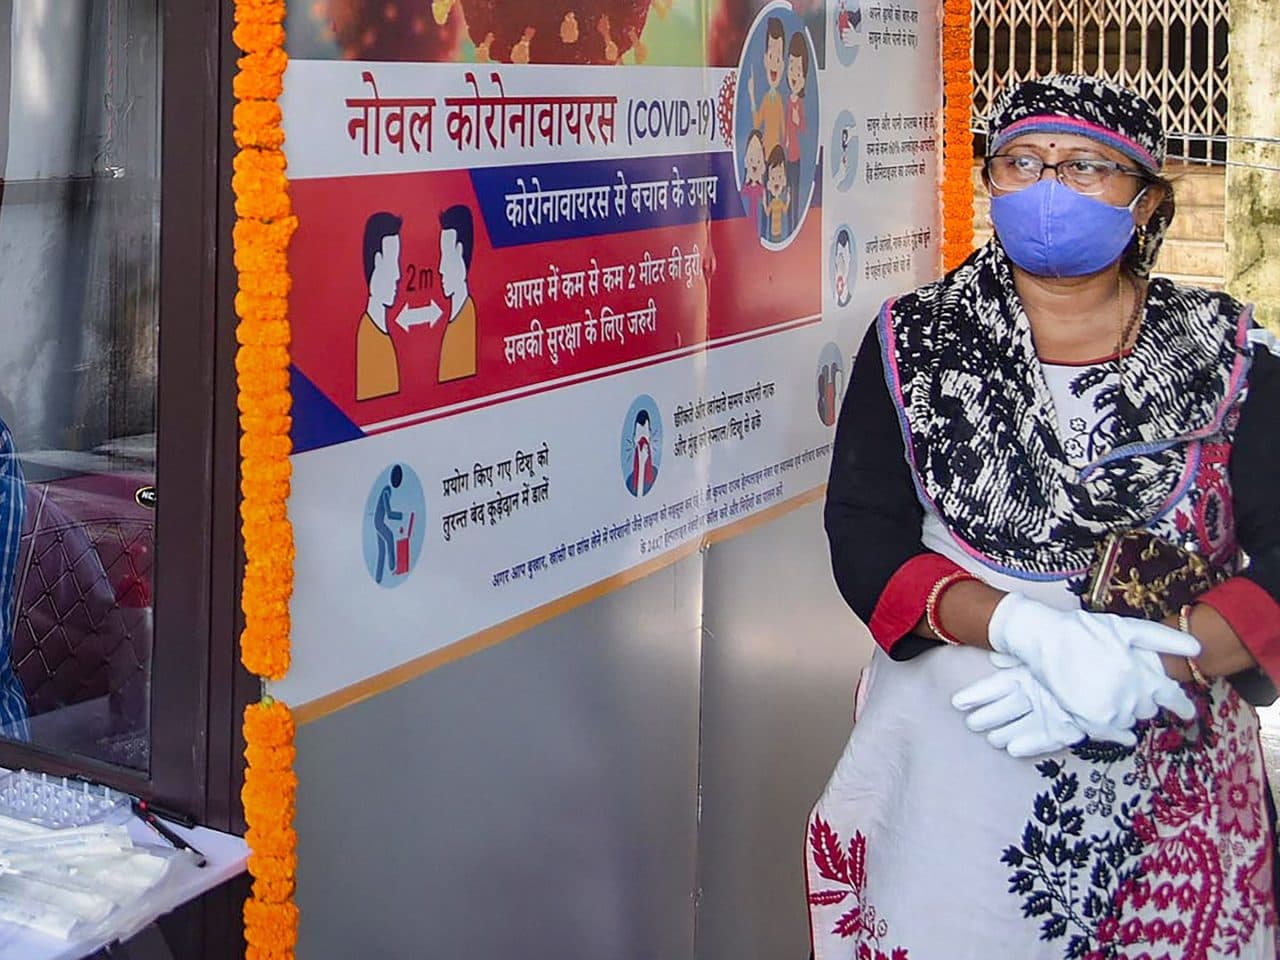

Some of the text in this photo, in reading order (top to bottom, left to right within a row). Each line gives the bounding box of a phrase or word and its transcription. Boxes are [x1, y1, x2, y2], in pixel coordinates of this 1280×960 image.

[345, 71, 716, 155] नोवल कोरोनावायरस (COVID-19)
[505, 167, 718, 228] कोरोनावायरस से बचाव के उपाय
[504, 277, 545, 309] आपस
[547, 264, 559, 301] में
[561, 270, 585, 299] कम
[588, 259, 600, 296] से
[602, 265, 624, 291] कम
[628, 264, 636, 289] 2
[639, 251, 666, 286] मीटर
[668, 246, 683, 280] की
[504, 319, 544, 364] सबकी
[546, 321, 583, 365] सुरक्षा
[584, 309, 598, 344] के
[600, 306, 625, 345] लिए
[442, 468, 469, 497] प्रयोग
[473, 462, 493, 488] किए
[497, 460, 512, 482] गए
[537, 441, 549, 468] को
[442, 509, 468, 541] तुरन्त
[470, 501, 485, 526] बंद
